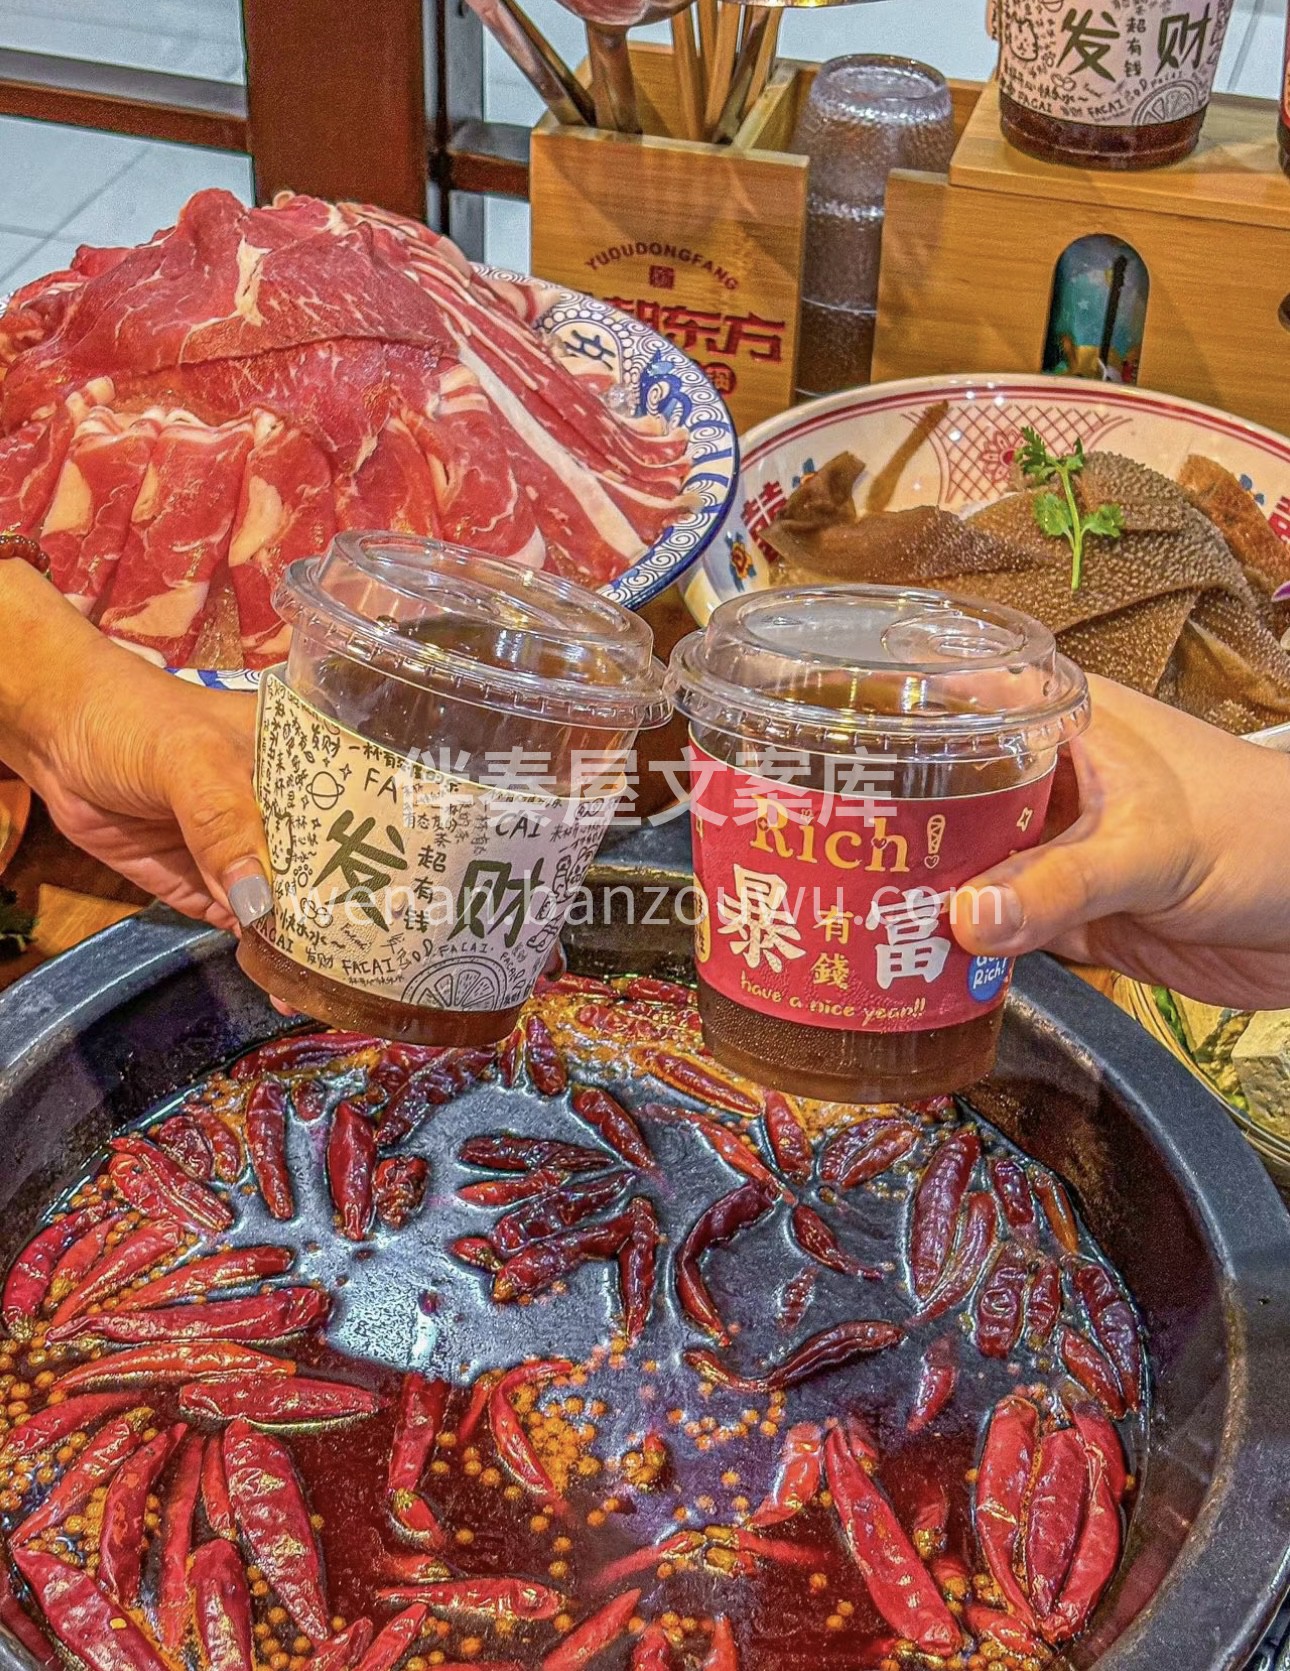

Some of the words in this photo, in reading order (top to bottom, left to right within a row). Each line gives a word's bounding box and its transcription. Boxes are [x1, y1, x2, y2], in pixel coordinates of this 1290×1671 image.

[1056, 8, 1120, 82] 发
[1154, 2, 1212, 77] 财
[313, 808, 410, 932] 发
[447, 857, 546, 948] 财
[716, 863, 807, 974] 暴
[865, 889, 957, 989] 富
[341, 956, 396, 977] FACAI
[741, 970, 783, 1003] have
[789, 996, 802, 1008] a
[809, 999, 856, 1017] nice
